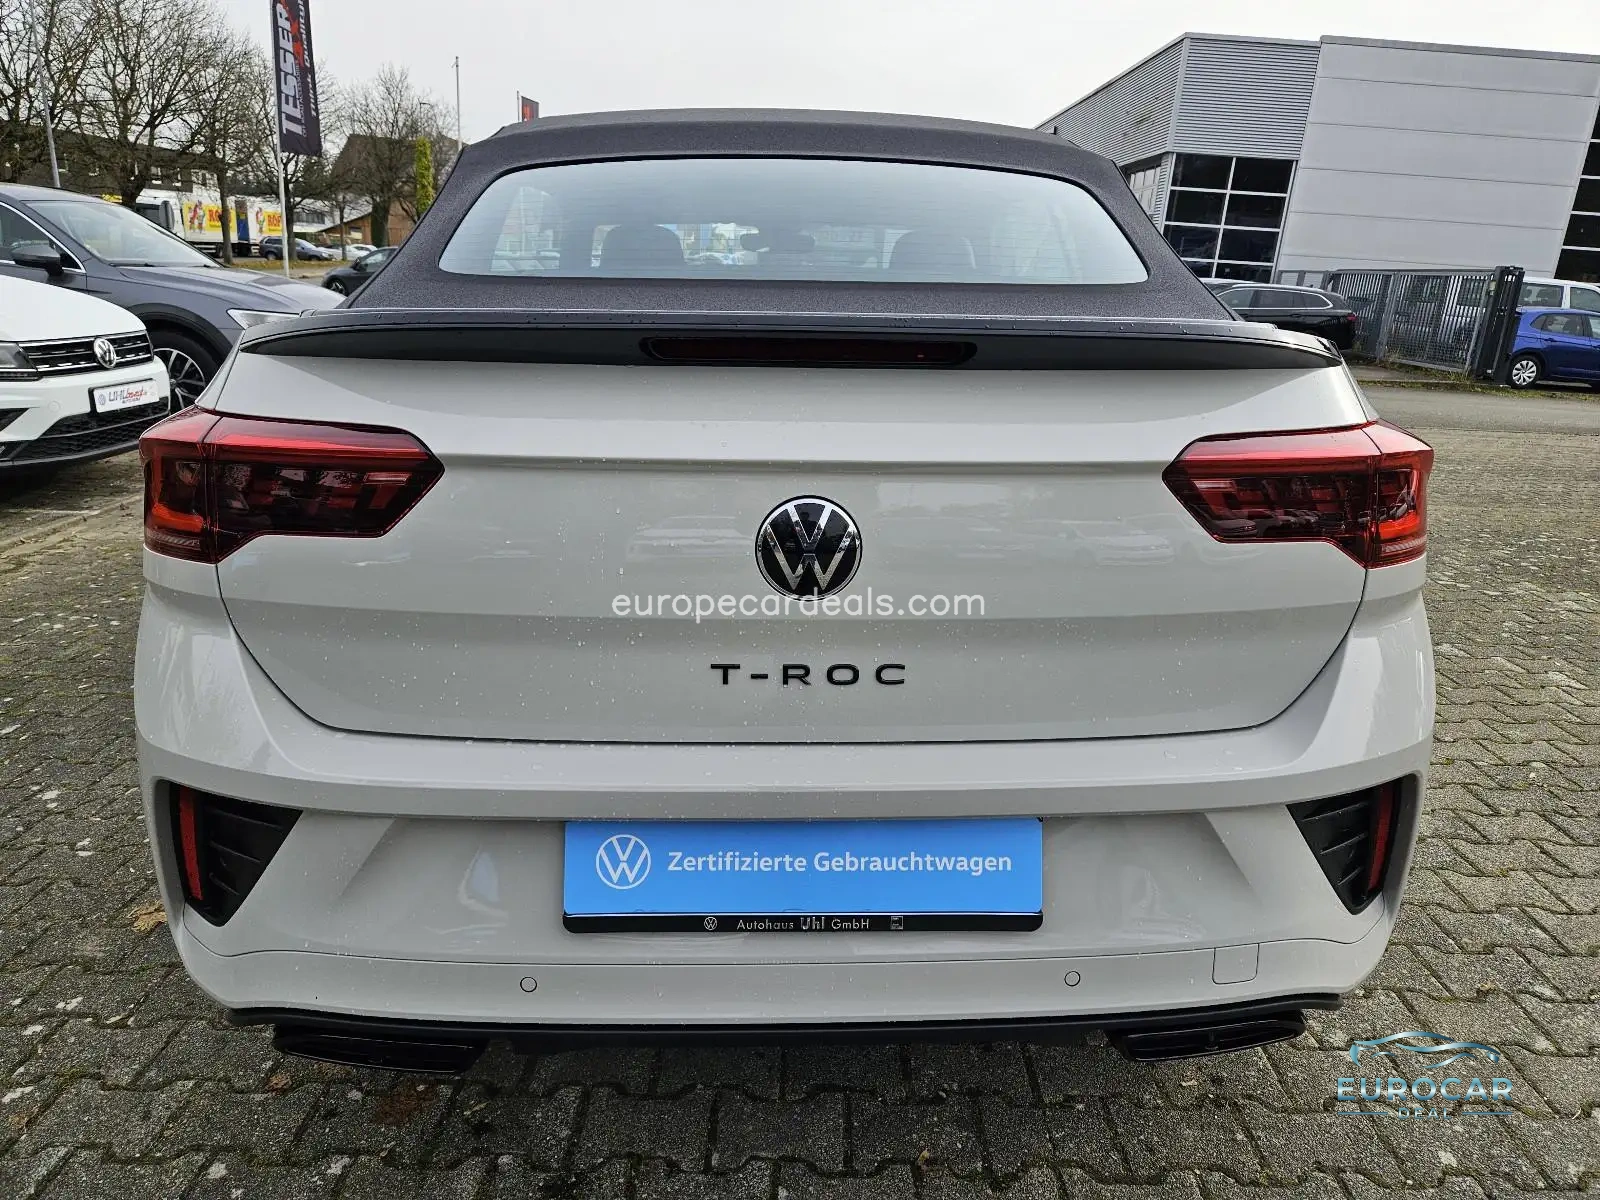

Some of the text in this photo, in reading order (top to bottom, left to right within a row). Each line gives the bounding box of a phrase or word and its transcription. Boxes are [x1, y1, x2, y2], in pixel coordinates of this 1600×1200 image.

[306, 72, 317, 117] Think
[710, 663, 906, 686] T-ROC
[667, 851, 1013, 876] Zertifizierte Gebrauchtwagen
[736, 916, 870, 930] Autohaus Uhl GmbH
